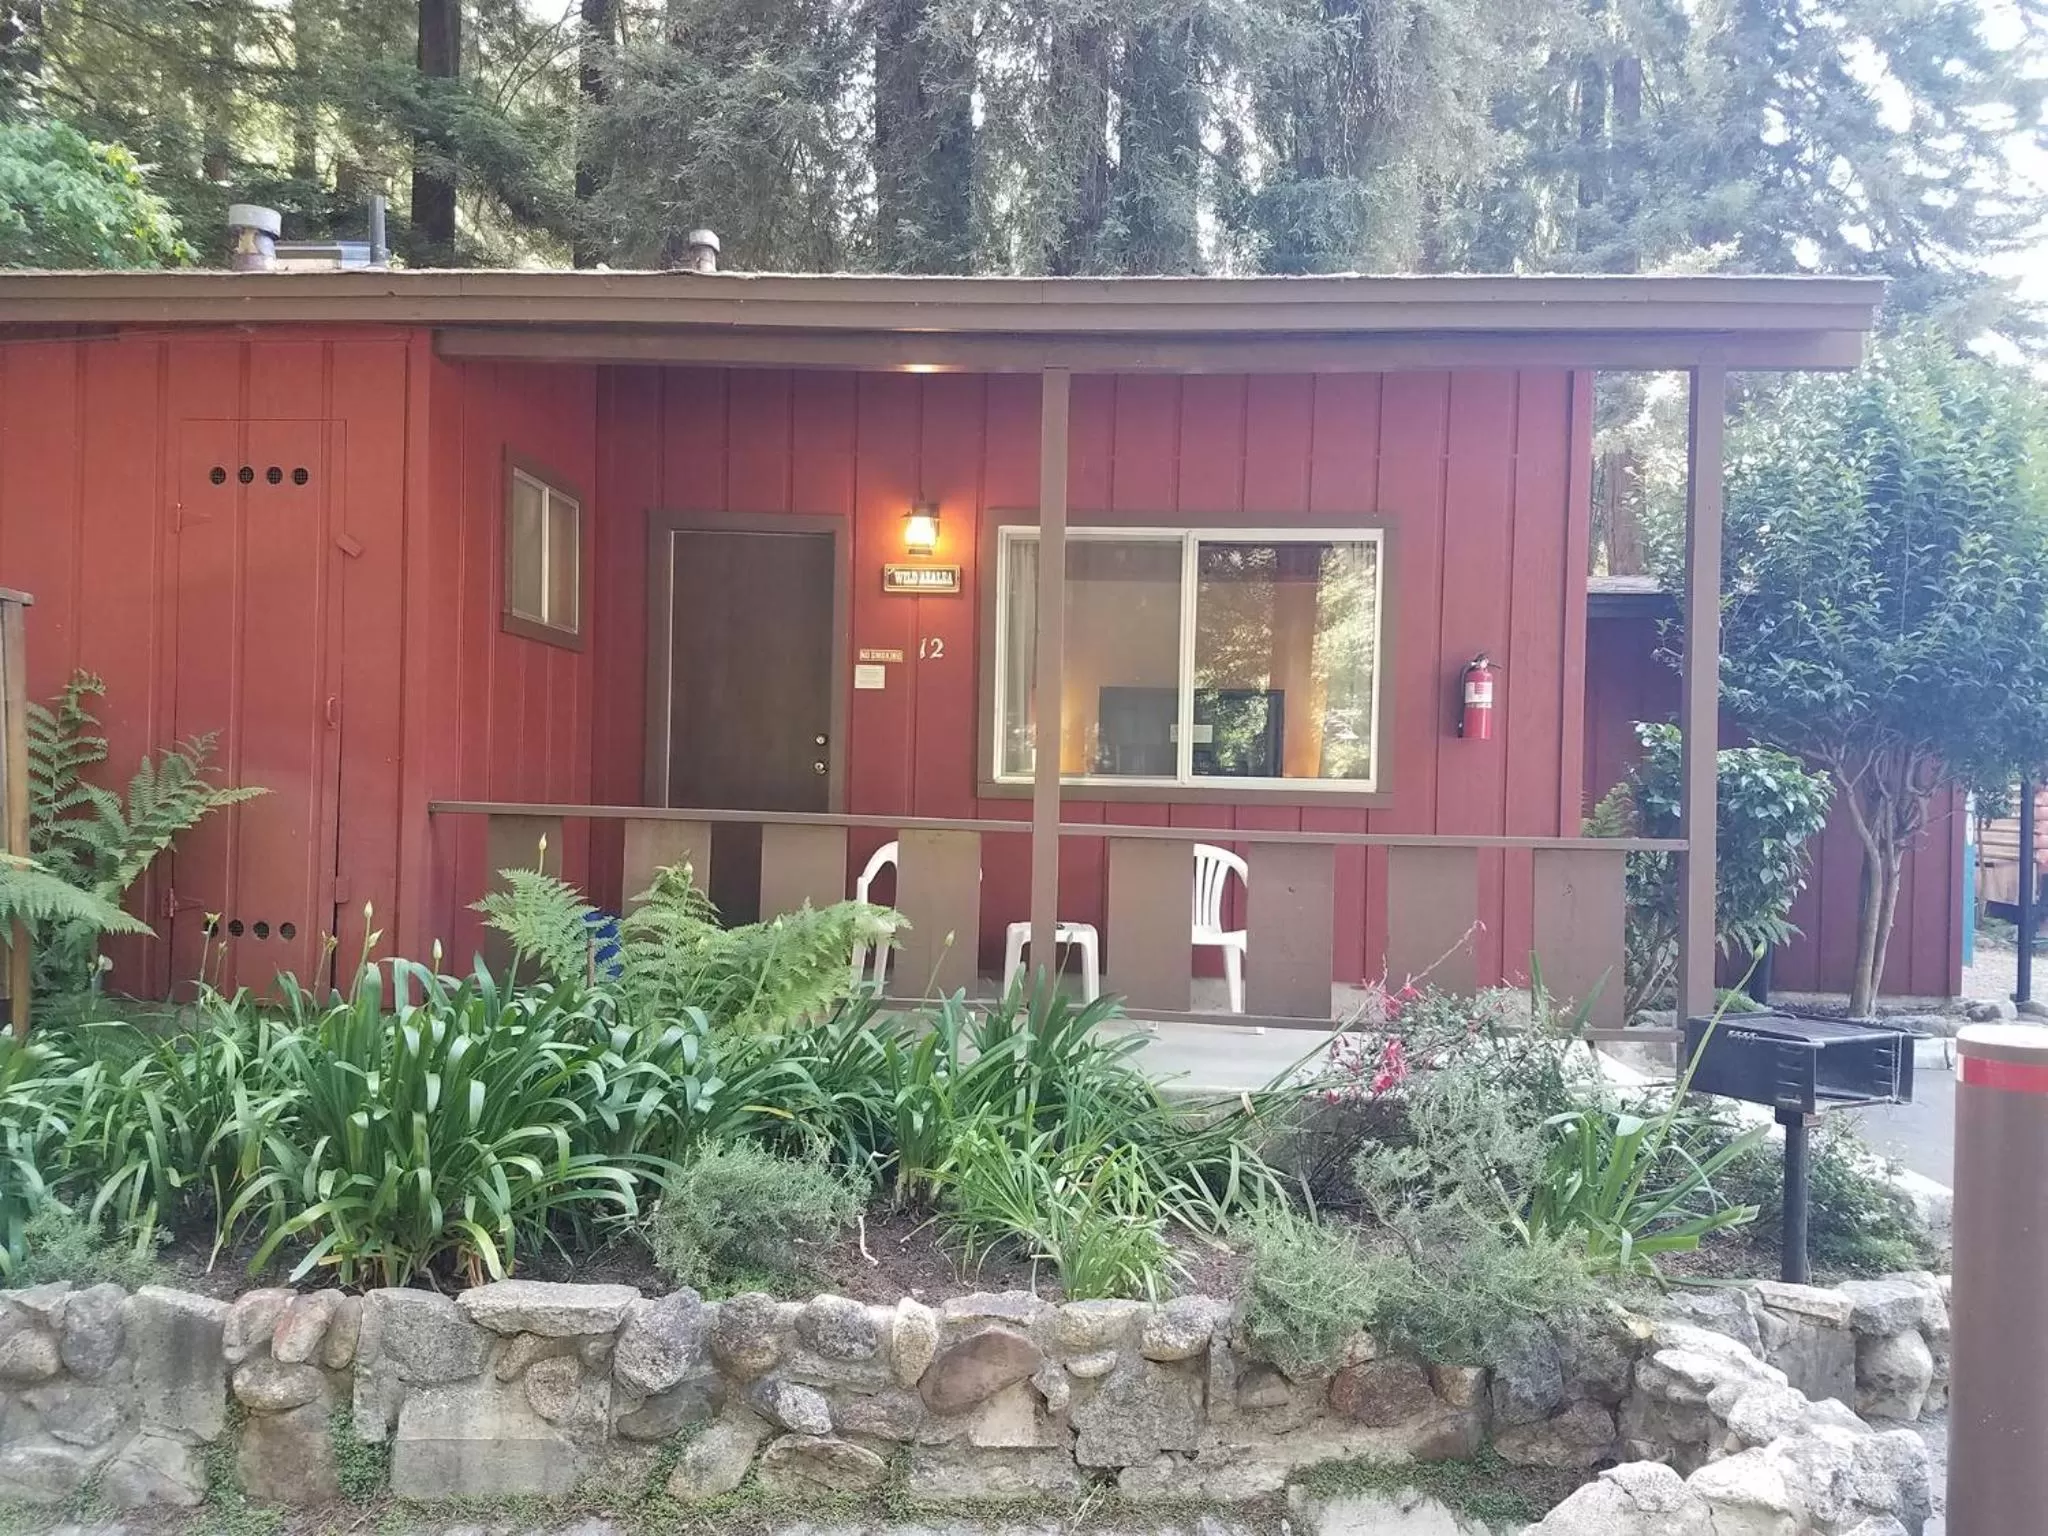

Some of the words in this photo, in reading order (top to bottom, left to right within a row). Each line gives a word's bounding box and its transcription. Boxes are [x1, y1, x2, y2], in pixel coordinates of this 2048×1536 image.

[895, 571, 918, 585] WILD
[919, 571, 953, 585] AZALEA
[860, 650, 870, 660] NO
[919, 637, 944, 659] 12
